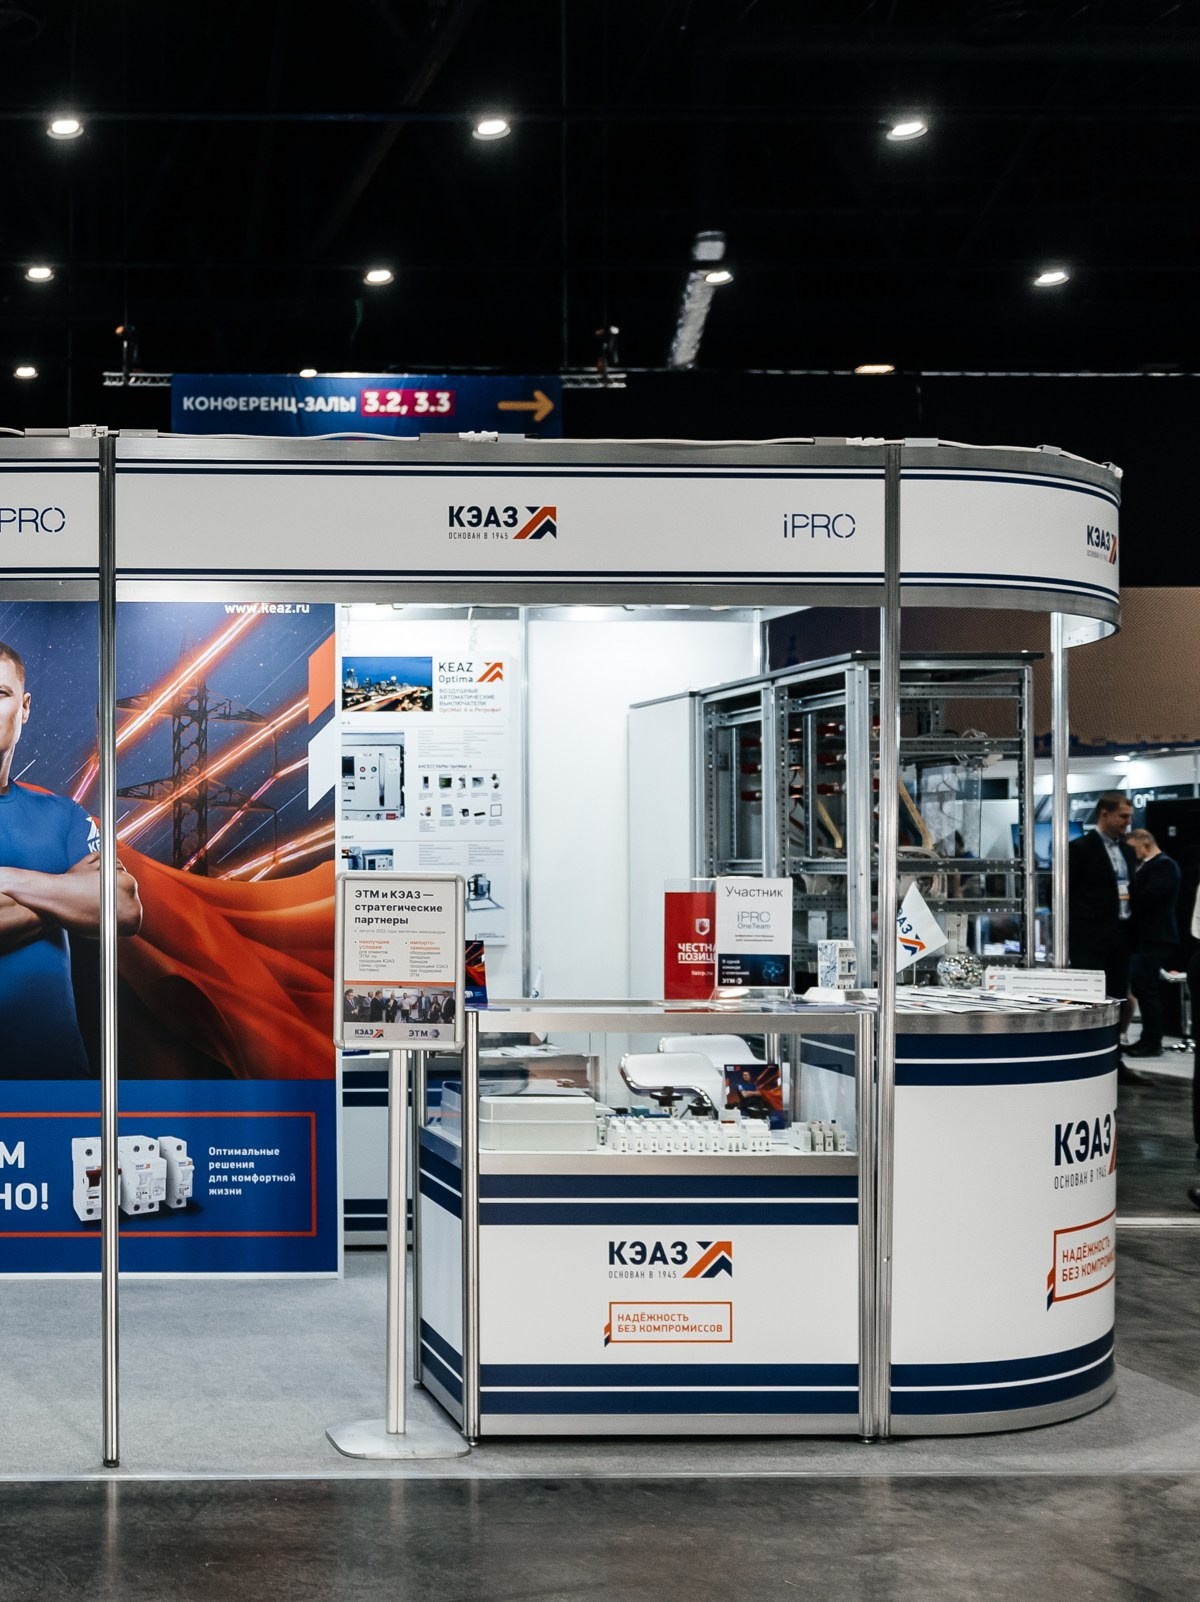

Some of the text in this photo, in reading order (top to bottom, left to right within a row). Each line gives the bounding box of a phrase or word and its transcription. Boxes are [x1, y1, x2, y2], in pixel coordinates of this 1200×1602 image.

[183, 392, 451, 415] КОНФЕРЕНЦ-ЗАЛЫ 3.2, 3.3
[448, 505, 518, 527] КЭАЗ
[783, 513, 856, 538] iPRO
[448, 531, 509, 540] ОСНОВАН В 1945
[1087, 524, 1111, 551] КЭАЗ
[224, 602, 310, 614] www.keaz.ru
[438, 662, 473, 673] KEAZ
[438, 674, 474, 685] Optima
[355, 889, 421, 899] ЭТМ и КЭАЗ
[725, 885, 784, 898] Участник
[354, 904, 443, 913] стратегические
[354, 916, 409, 926] партнеры
[737, 910, 771, 923] iPRO
[354, 1028, 428, 1037] КЭАЗ ЭТМ
[1054, 1113, 1112, 1167] КЭАЗ
[208, 1146, 280, 1156] Оптимальные
[208, 1161, 255, 1171] решения
[208, 1173, 296, 1184] для комфортной
[1054, 1172, 1088, 1190] ОСНОВАН
[1090, 1169, 1094, 1183] В
[608, 1240, 689, 1266] КЭАЗ
[608, 1270, 677, 1278] ОСНОВАН В 1945
[1062, 1266, 1080, 1282] БЕЗ
[617, 1311, 689, 1323] НАДЁЖНОСТЬ
[617, 1324, 723, 1333] БЕЗ КОМПРОМИССОВ
